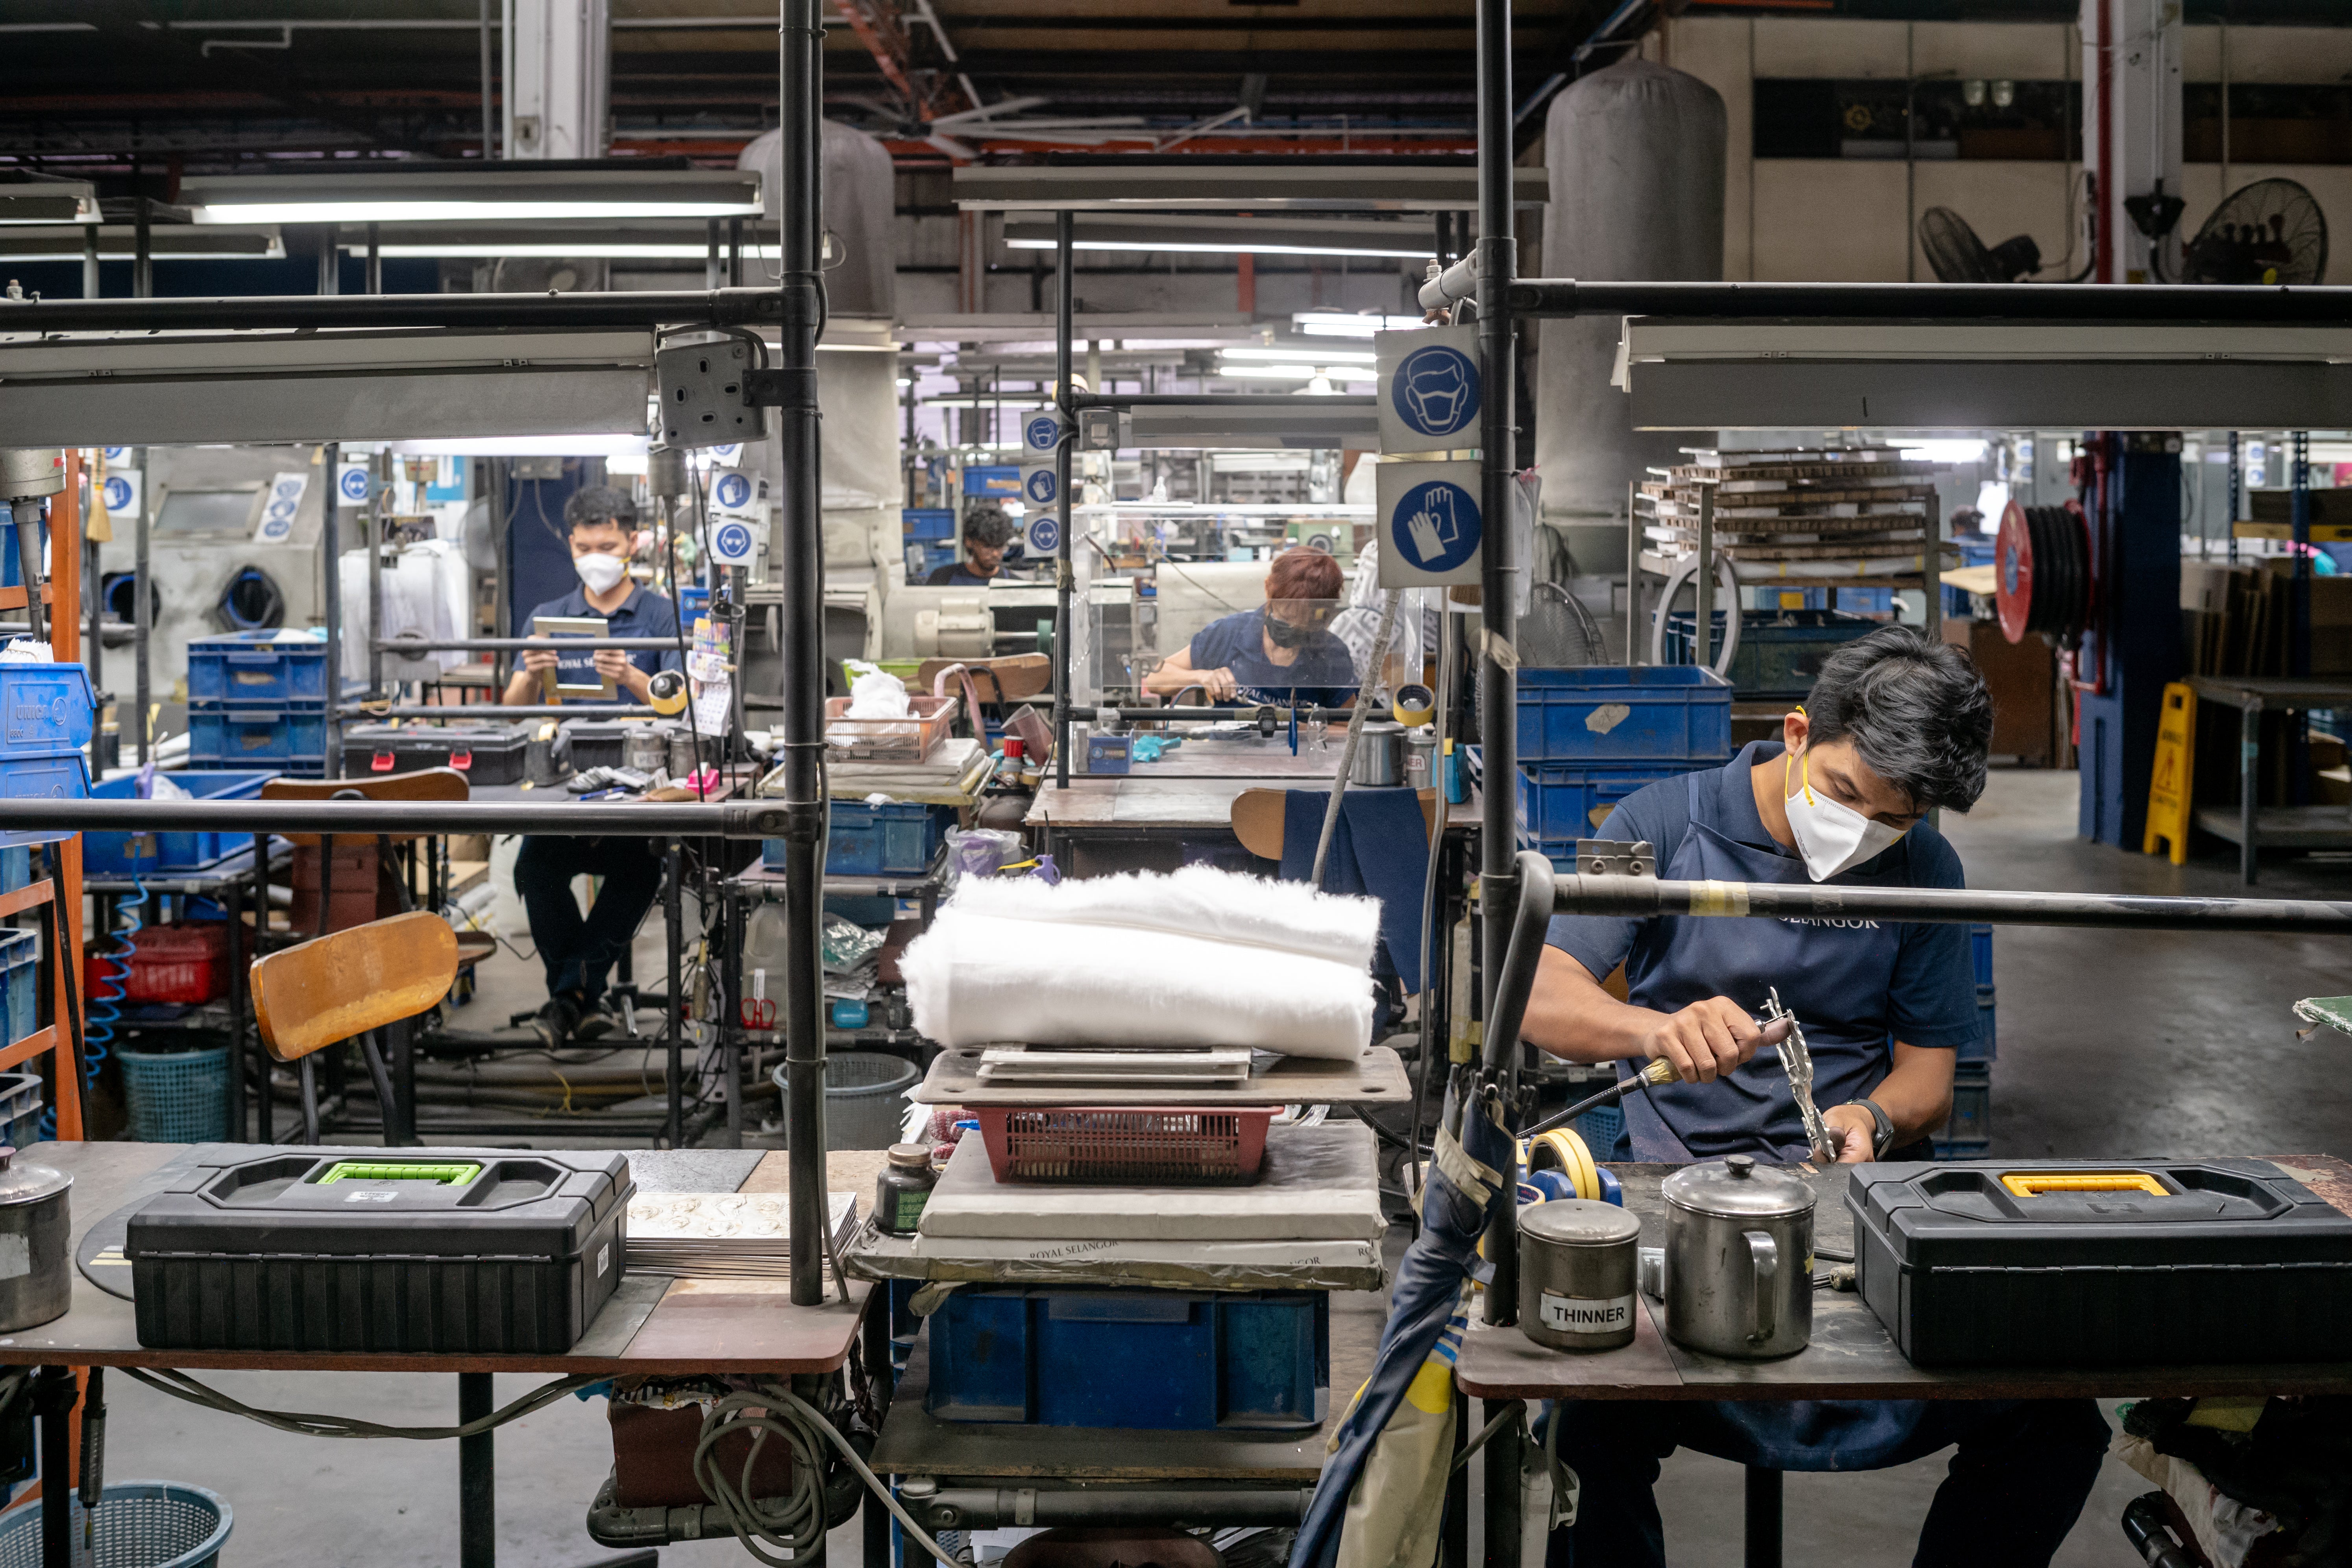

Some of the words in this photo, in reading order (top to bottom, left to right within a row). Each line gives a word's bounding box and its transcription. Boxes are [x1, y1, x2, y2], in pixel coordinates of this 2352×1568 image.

[17, 705, 48, 720] UNICA
[1778, 917, 1880, 929] ANGOR
[1030, 1248, 1063, 1258] ROYAL
[1065, 1240, 1119, 1255] SELANGOR
[1553, 1306, 1625, 1324] THINNER
